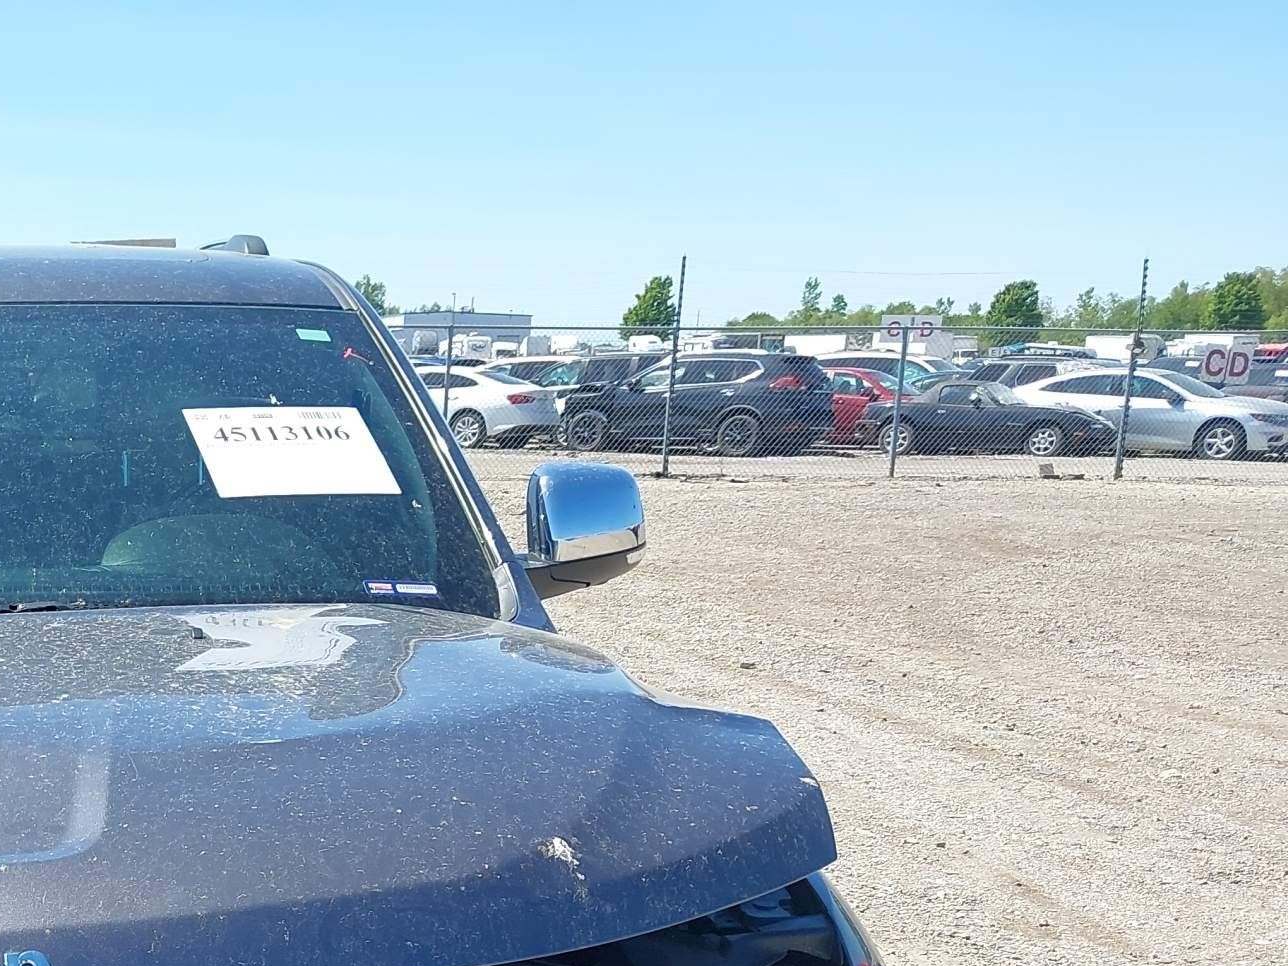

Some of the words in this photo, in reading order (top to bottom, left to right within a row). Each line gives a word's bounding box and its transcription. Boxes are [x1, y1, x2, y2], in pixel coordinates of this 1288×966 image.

[887, 321, 901, 337] C
[919, 321, 934, 337] D
[1205, 349, 1226, 377] C
[1228, 351, 1250, 377] D
[213, 425, 351, 442] 45113106
